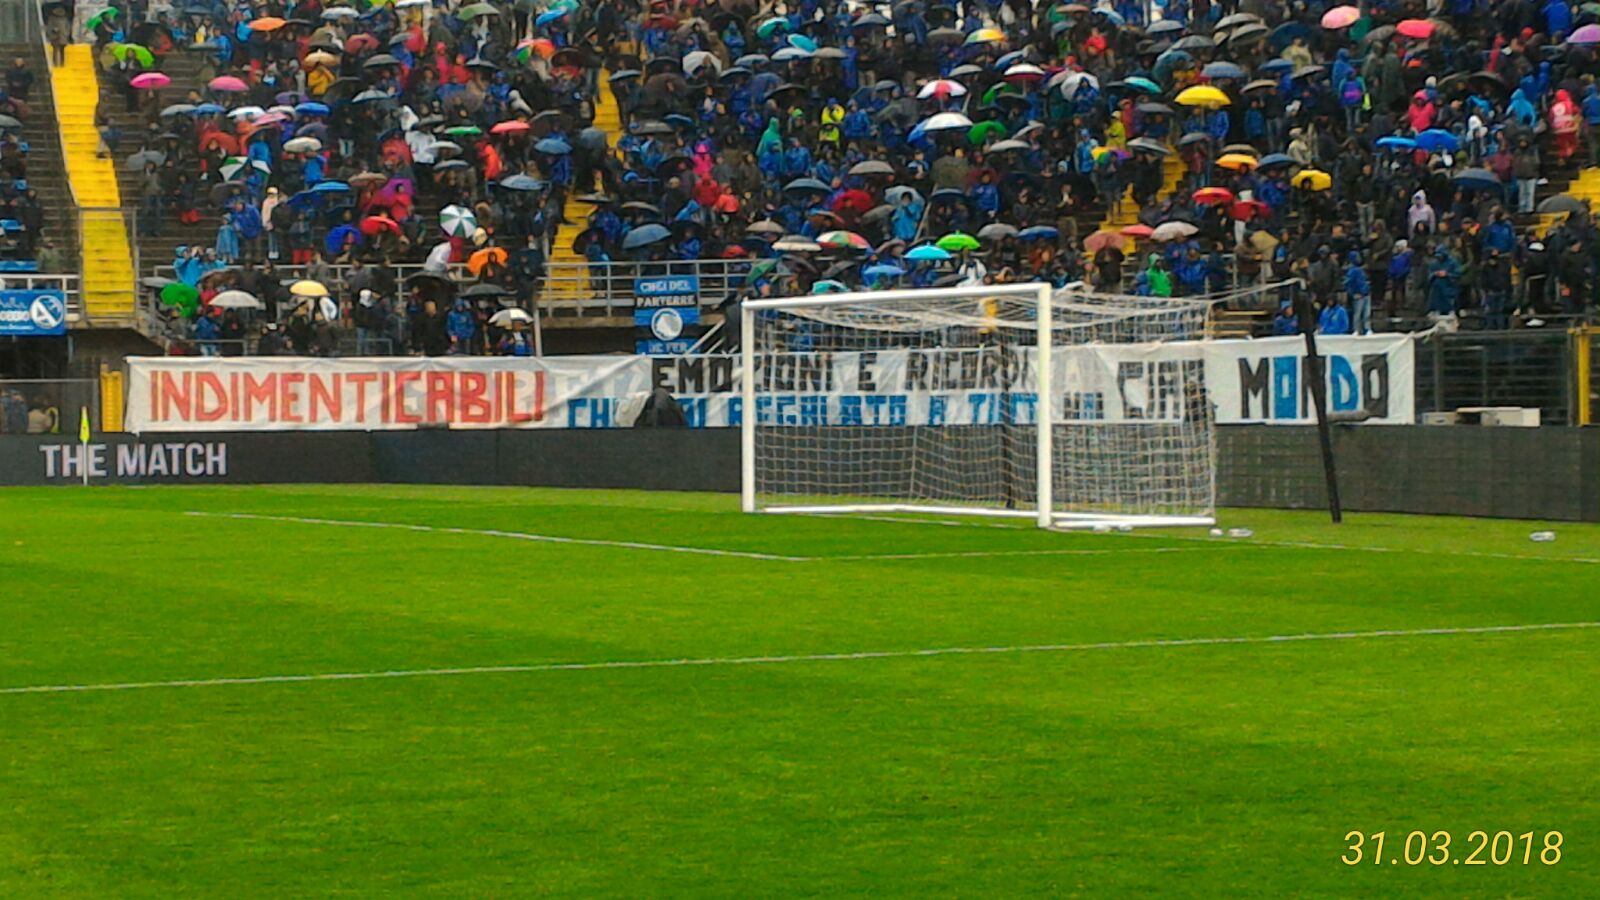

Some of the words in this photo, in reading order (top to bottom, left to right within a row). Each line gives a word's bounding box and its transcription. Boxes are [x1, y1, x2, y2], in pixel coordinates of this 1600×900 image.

[637, 295, 696, 307] PARTERRE
[858, 352, 877, 391] E
[1238, 353, 1389, 420] MONDO
[150, 370, 544, 424] INDIMENTICABILI
[39, 444, 108, 477] THE
[116, 442, 227, 476] MATCH
